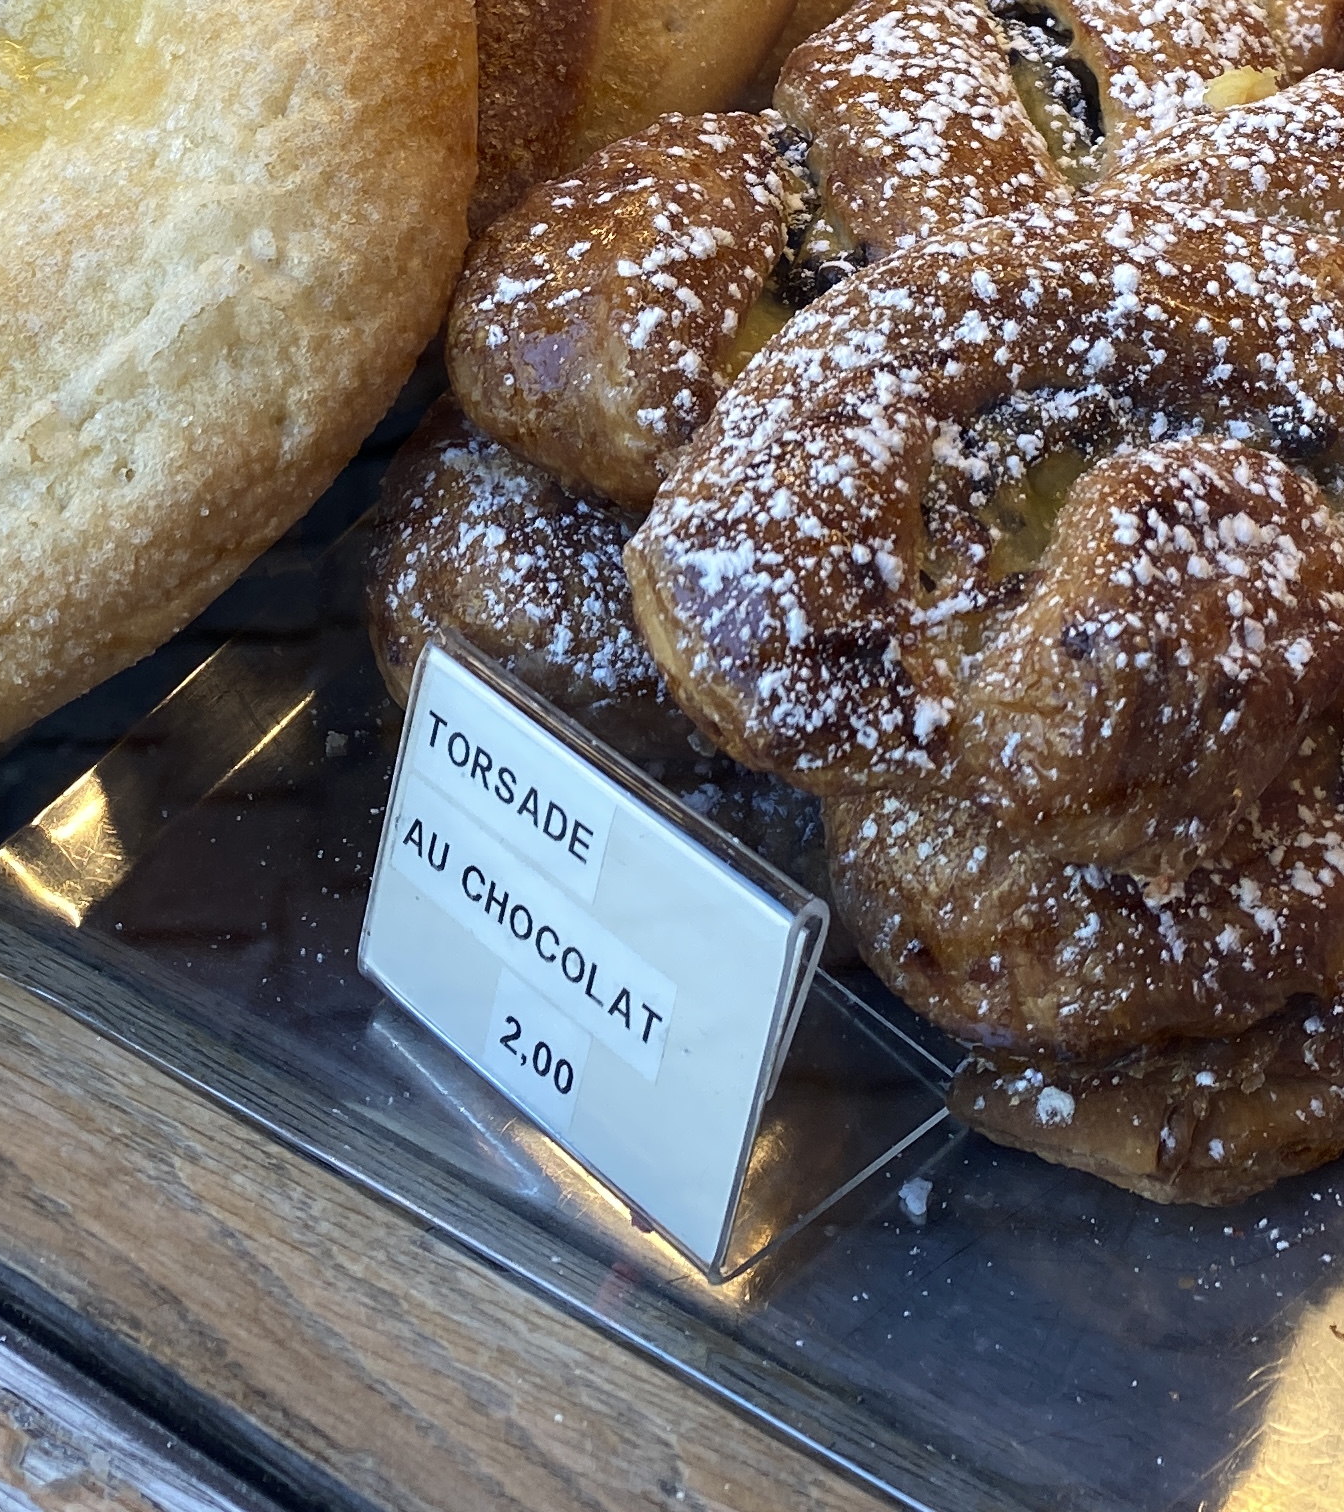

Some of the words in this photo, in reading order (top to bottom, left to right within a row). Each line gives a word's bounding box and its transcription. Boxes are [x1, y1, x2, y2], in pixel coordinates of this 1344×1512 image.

[428, 710, 594, 865] TORSADE
[403, 818, 449, 872] AU
[461, 863, 663, 1045] CHOCOLAT
[499, 1015, 574, 1096] 2,00
